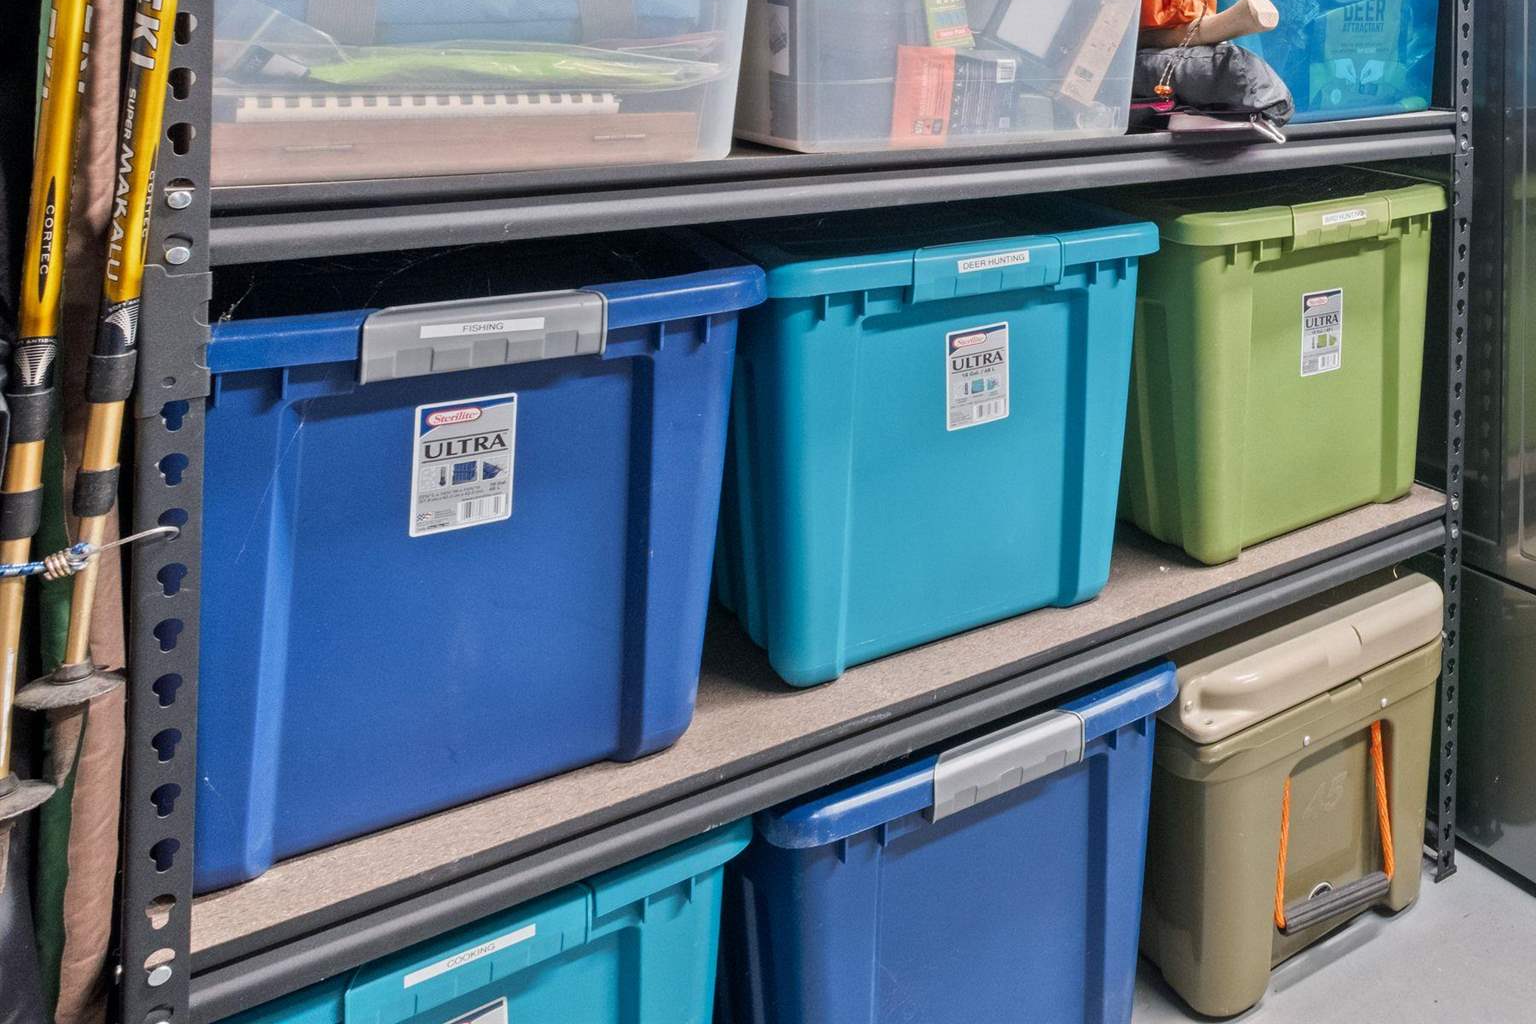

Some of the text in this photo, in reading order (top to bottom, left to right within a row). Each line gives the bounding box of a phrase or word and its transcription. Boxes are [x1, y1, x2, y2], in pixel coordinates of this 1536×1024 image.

[106, 87, 137, 282] SUPER MAKALU
[40, 204, 54, 275] CORTEC
[963, 254, 1025, 270] DEER HUNTING
[462, 322, 504, 333] FISHING
[1305, 314, 1339, 328] ULTRA
[952, 351, 1003, 371] ULTRA
[434, 411, 474, 424] Sterilite
[425, 434, 506, 459] ULTRA
[447, 943, 496, 968] COOKING
